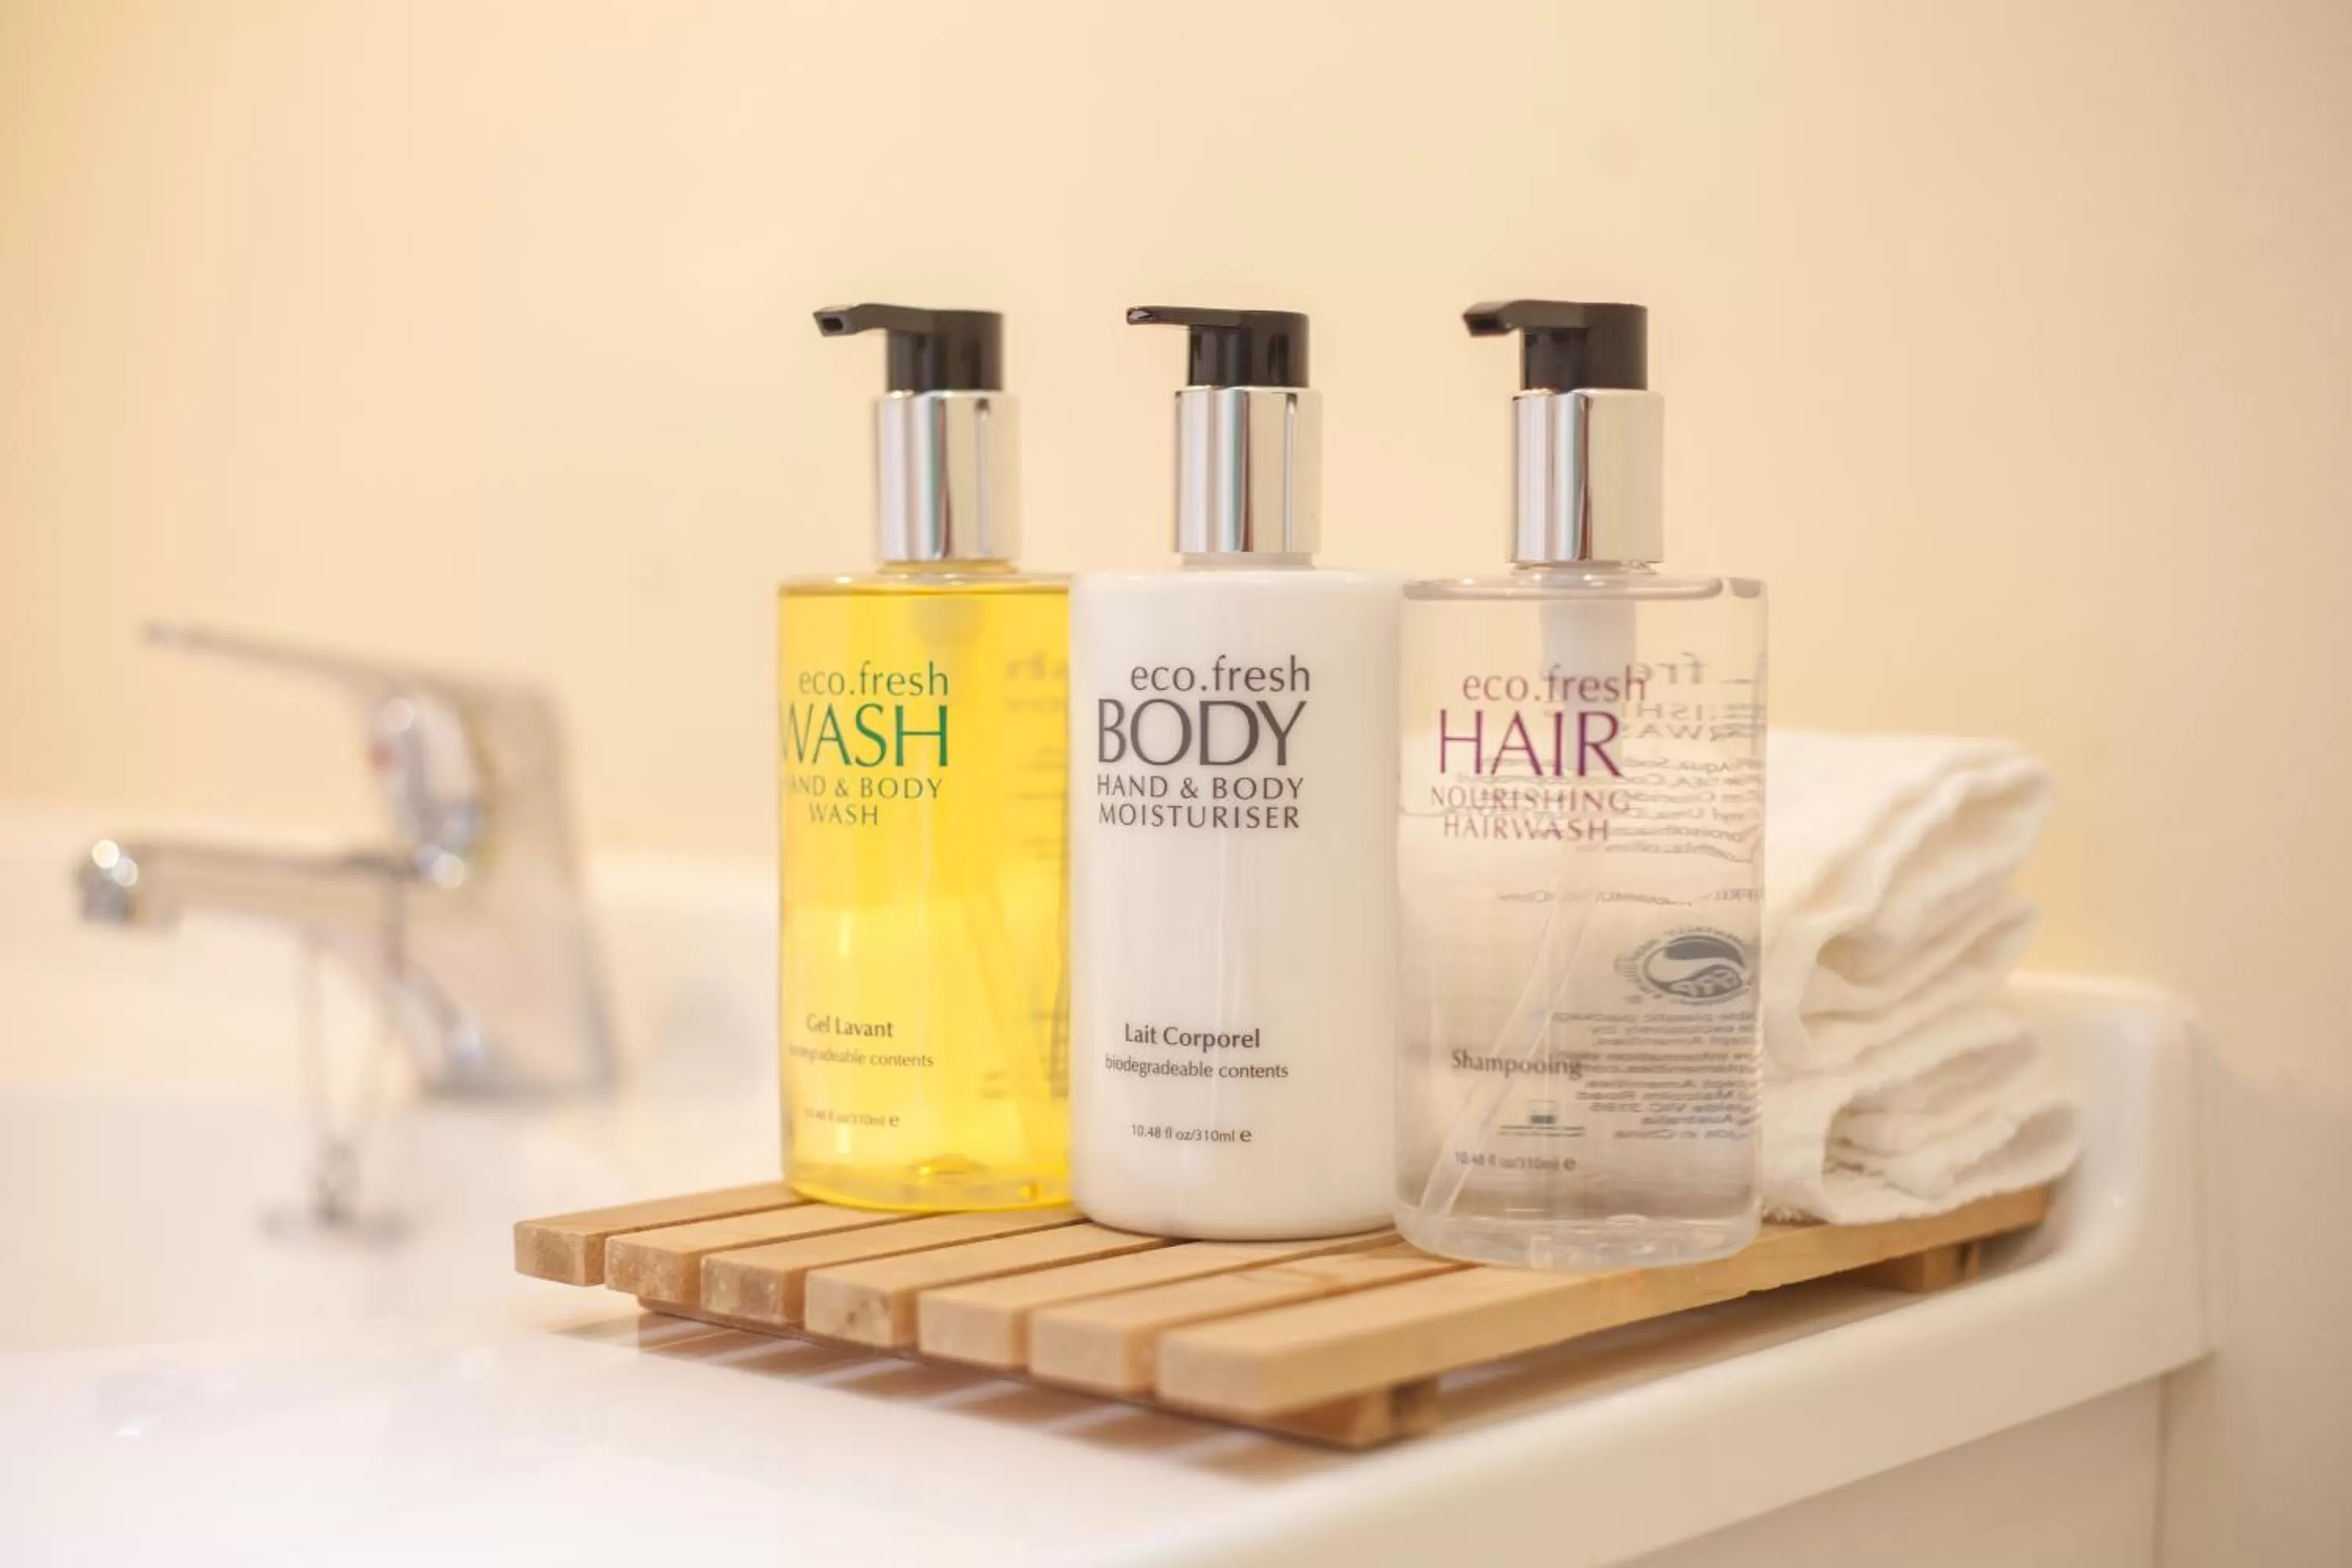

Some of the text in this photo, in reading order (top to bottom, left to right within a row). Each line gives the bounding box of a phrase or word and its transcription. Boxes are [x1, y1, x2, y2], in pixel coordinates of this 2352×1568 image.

[798, 660, 949, 696] eco.fresh
[1130, 653, 1310, 692] eco.fresh
[1463, 663, 1646, 703] eco.fresh
[1097, 698, 1308, 766] BODY
[1439, 709, 1624, 778] HAIR
[782, 774, 943, 800] AND & BODY
[1097, 773, 1305, 800] HAND & BODY
[1431, 785, 1630, 815] NOURISHING
[808, 801, 879, 826] WASH
[1098, 801, 1300, 829] MOISTURISER
[1443, 817, 1610, 841] HAIRWASH
[806, 1013, 895, 1039] Gel Lavant
[1124, 1023, 1261, 1053] Lait Corporel
[869, 1052, 935, 1068] contents
[1104, 1053, 1289, 1079] biodegradeable contents
[1452, 1049, 1583, 1080] Shampooing
[1131, 1123, 1162, 1139] 10.48
[1175, 1127, 1236, 1143] oz/310ml
